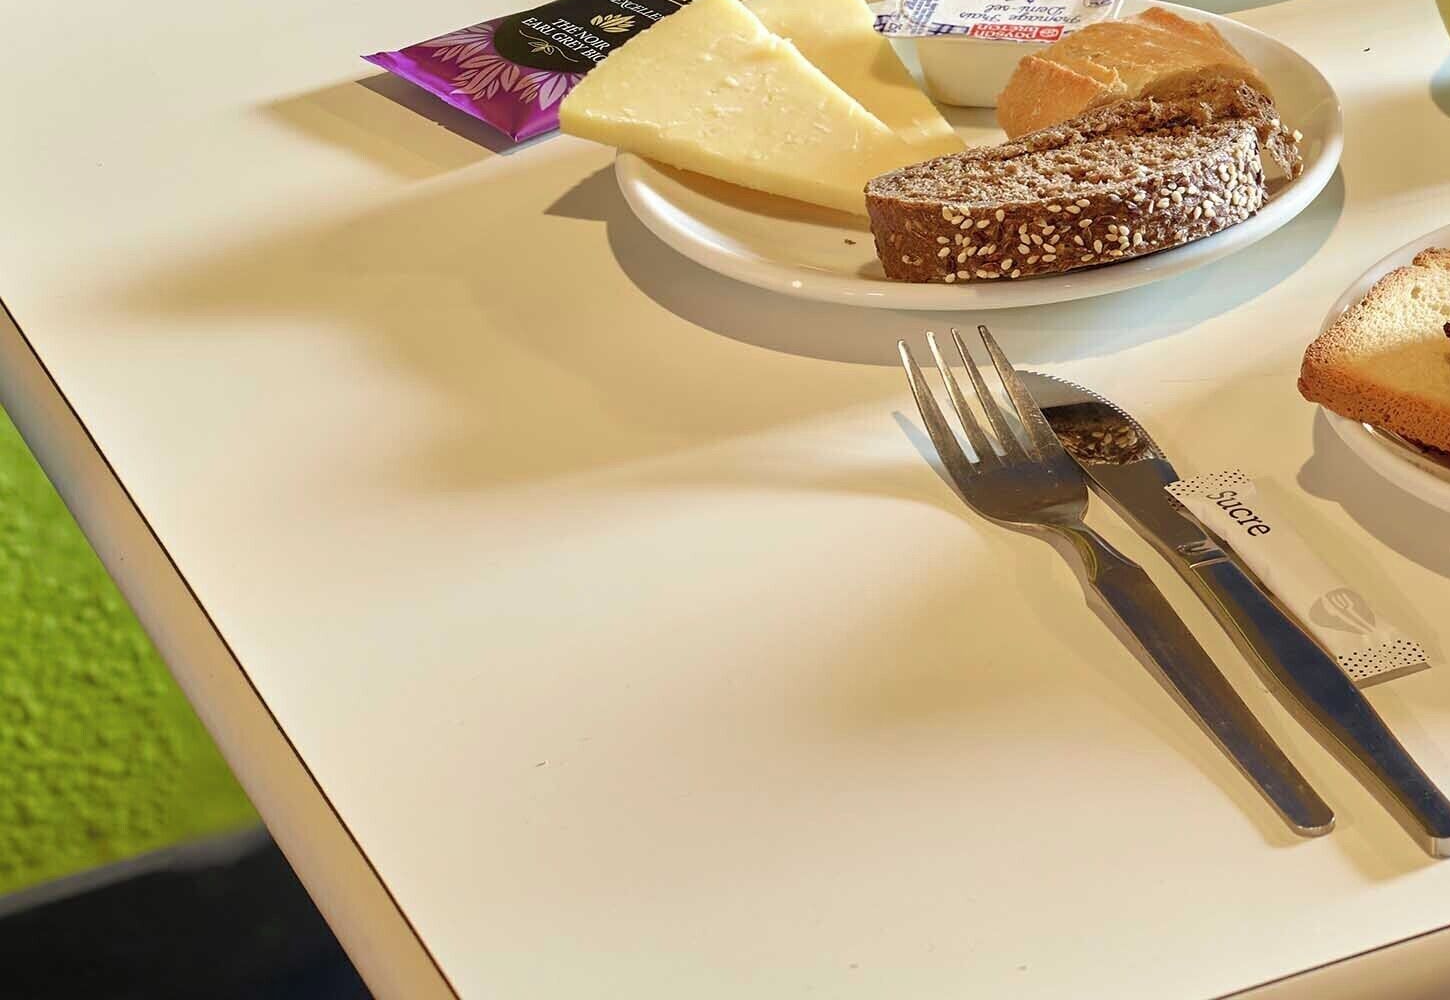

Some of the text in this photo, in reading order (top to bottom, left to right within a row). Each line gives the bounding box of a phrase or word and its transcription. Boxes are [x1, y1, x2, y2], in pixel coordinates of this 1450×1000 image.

[522, 17, 553, 35] EARL
[552, 31, 588, 51] GREY
[578, 31, 610, 50] NOIR
[1207, 487, 1271, 538] Sucre
